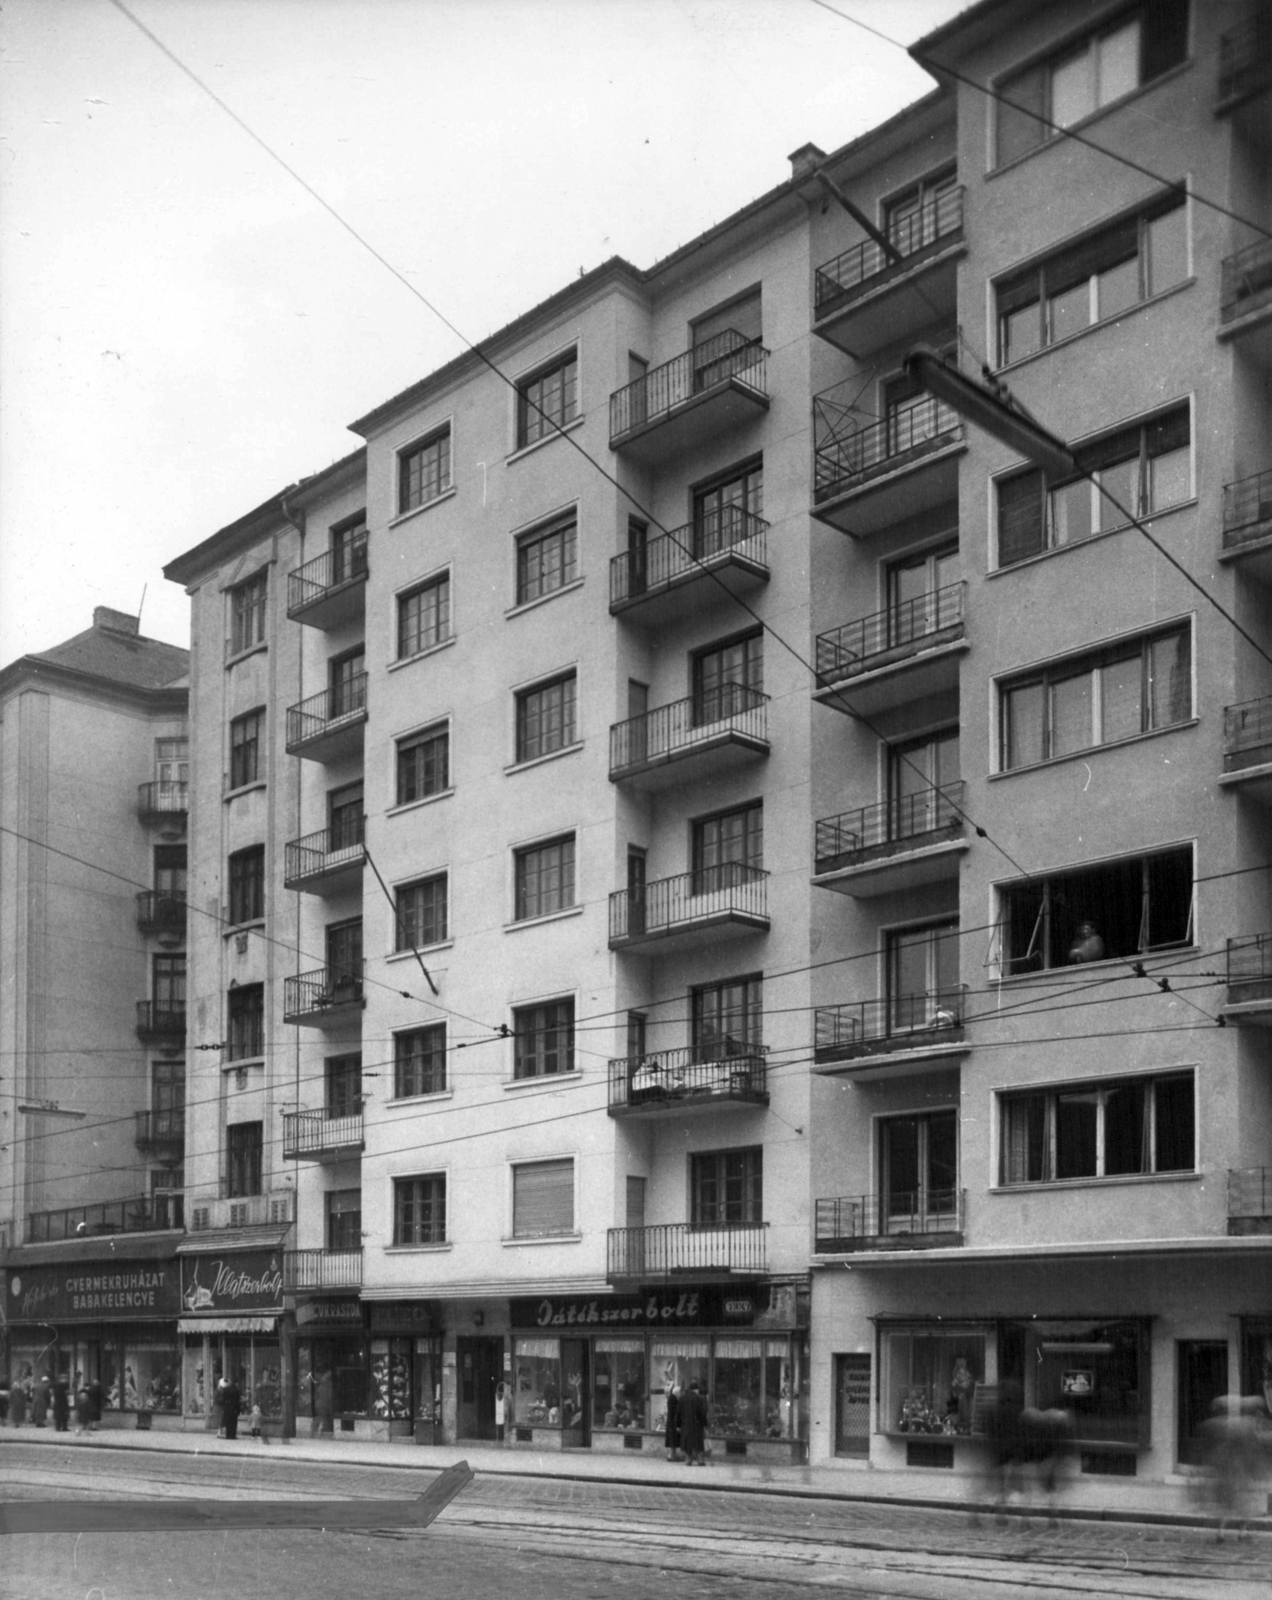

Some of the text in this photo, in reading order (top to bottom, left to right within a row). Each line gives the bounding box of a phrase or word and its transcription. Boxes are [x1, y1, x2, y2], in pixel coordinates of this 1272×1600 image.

[66, 1269, 165, 1292] GYERMEKRUHÁZAT
[210, 1260, 283, 1301] Illatszerbolt
[73, 1291, 155, 1309] BABAKELENGYE
[537, 1293, 699, 1326] Játékszerbolt
